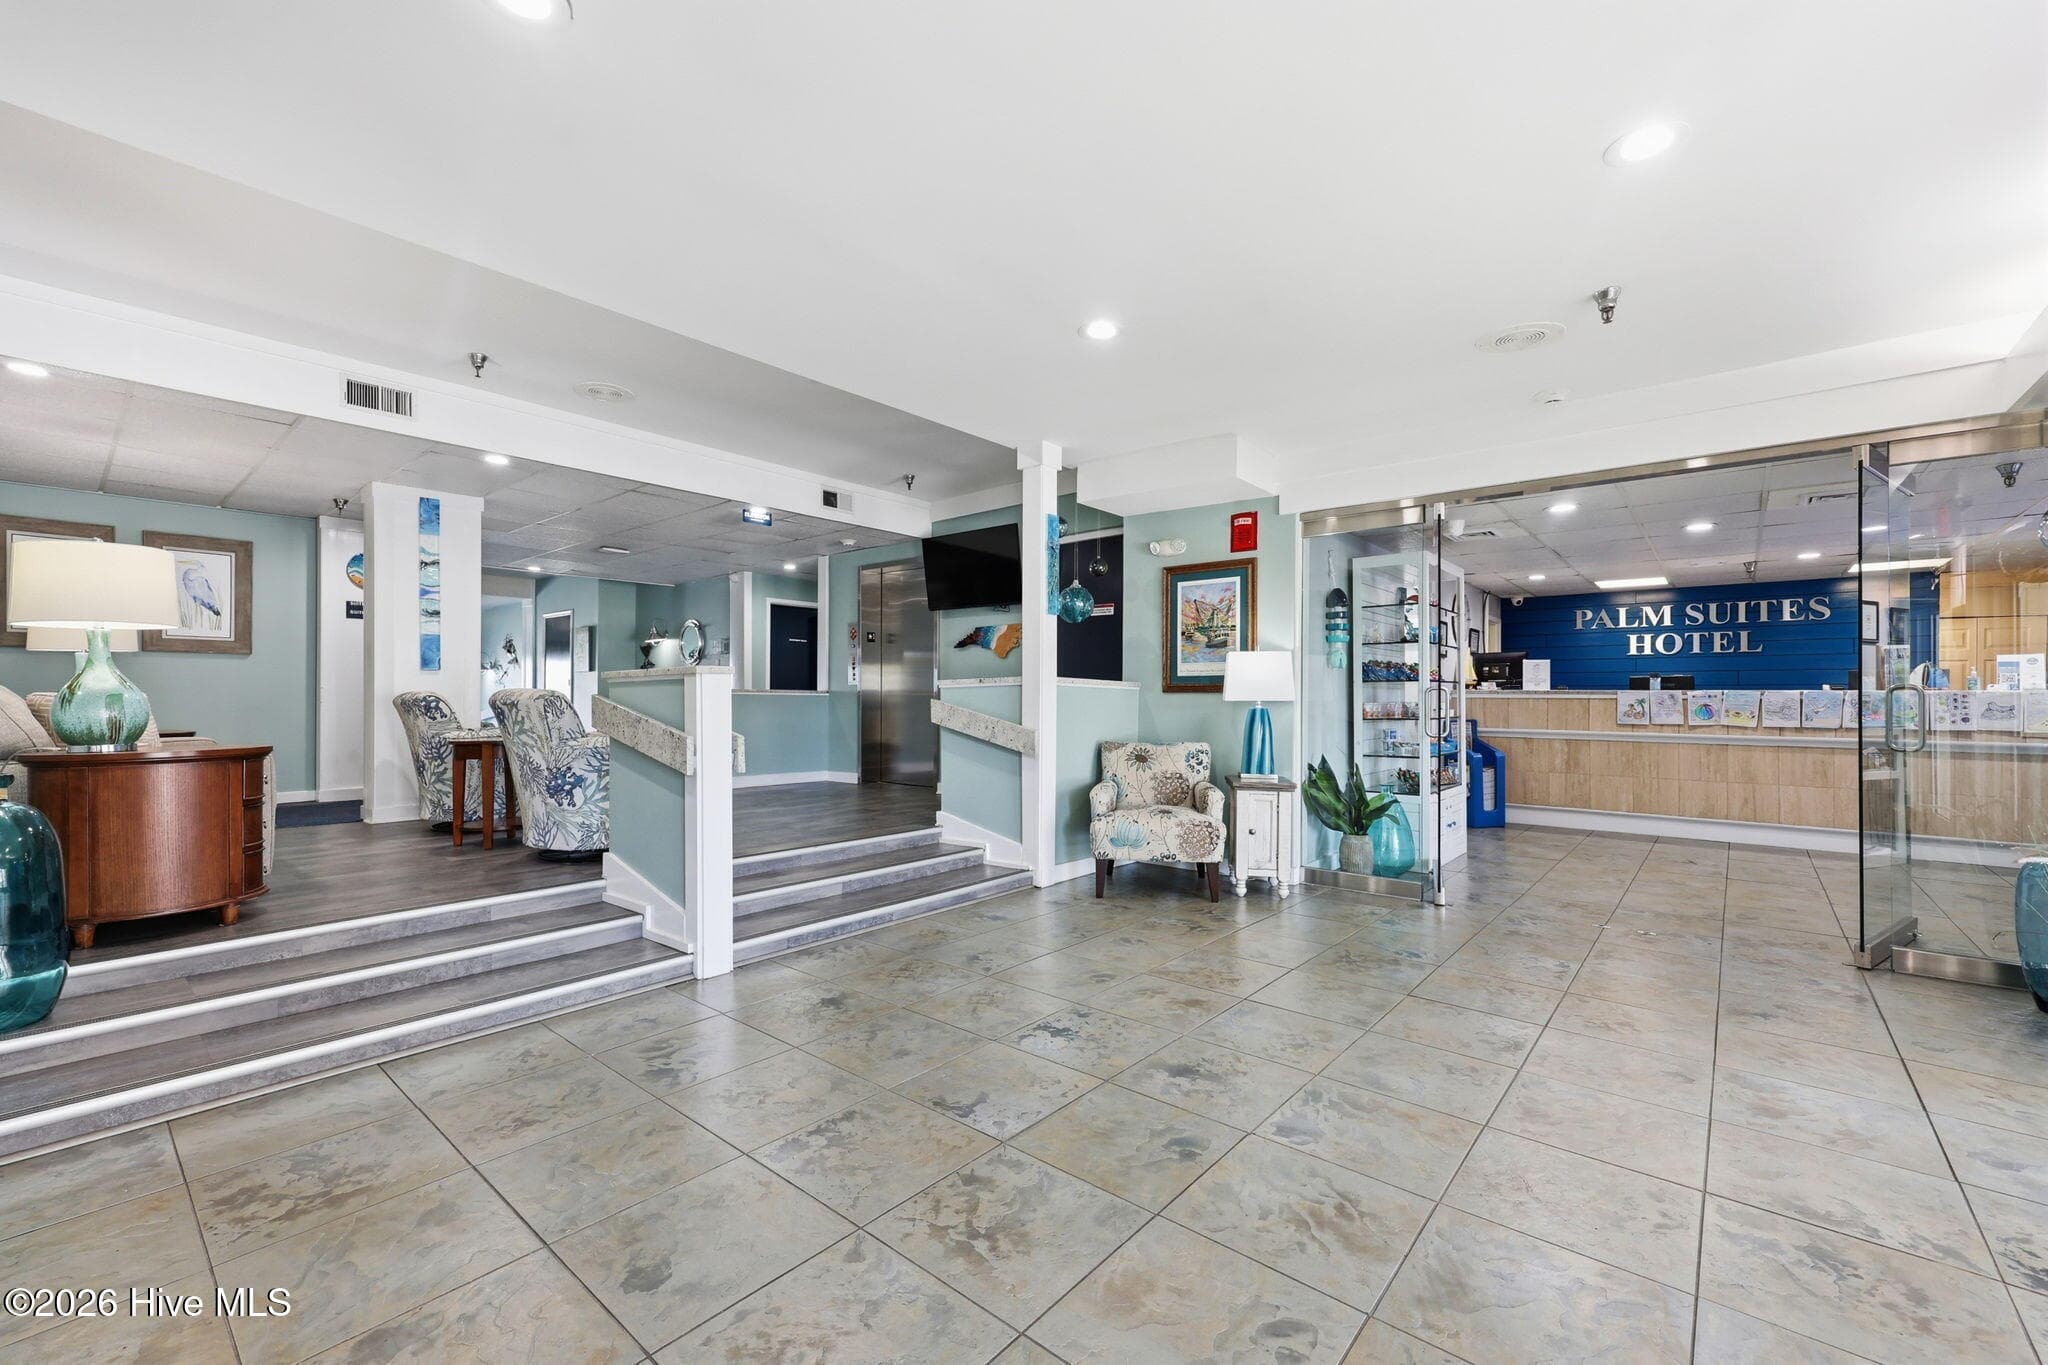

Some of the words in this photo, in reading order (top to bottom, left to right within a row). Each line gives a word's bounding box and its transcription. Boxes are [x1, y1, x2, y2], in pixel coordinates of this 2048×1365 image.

[1574, 604, 1676, 631] PALM
[1684, 596, 1832, 627] SUITES
[1627, 630, 1762, 656] HOTEL
